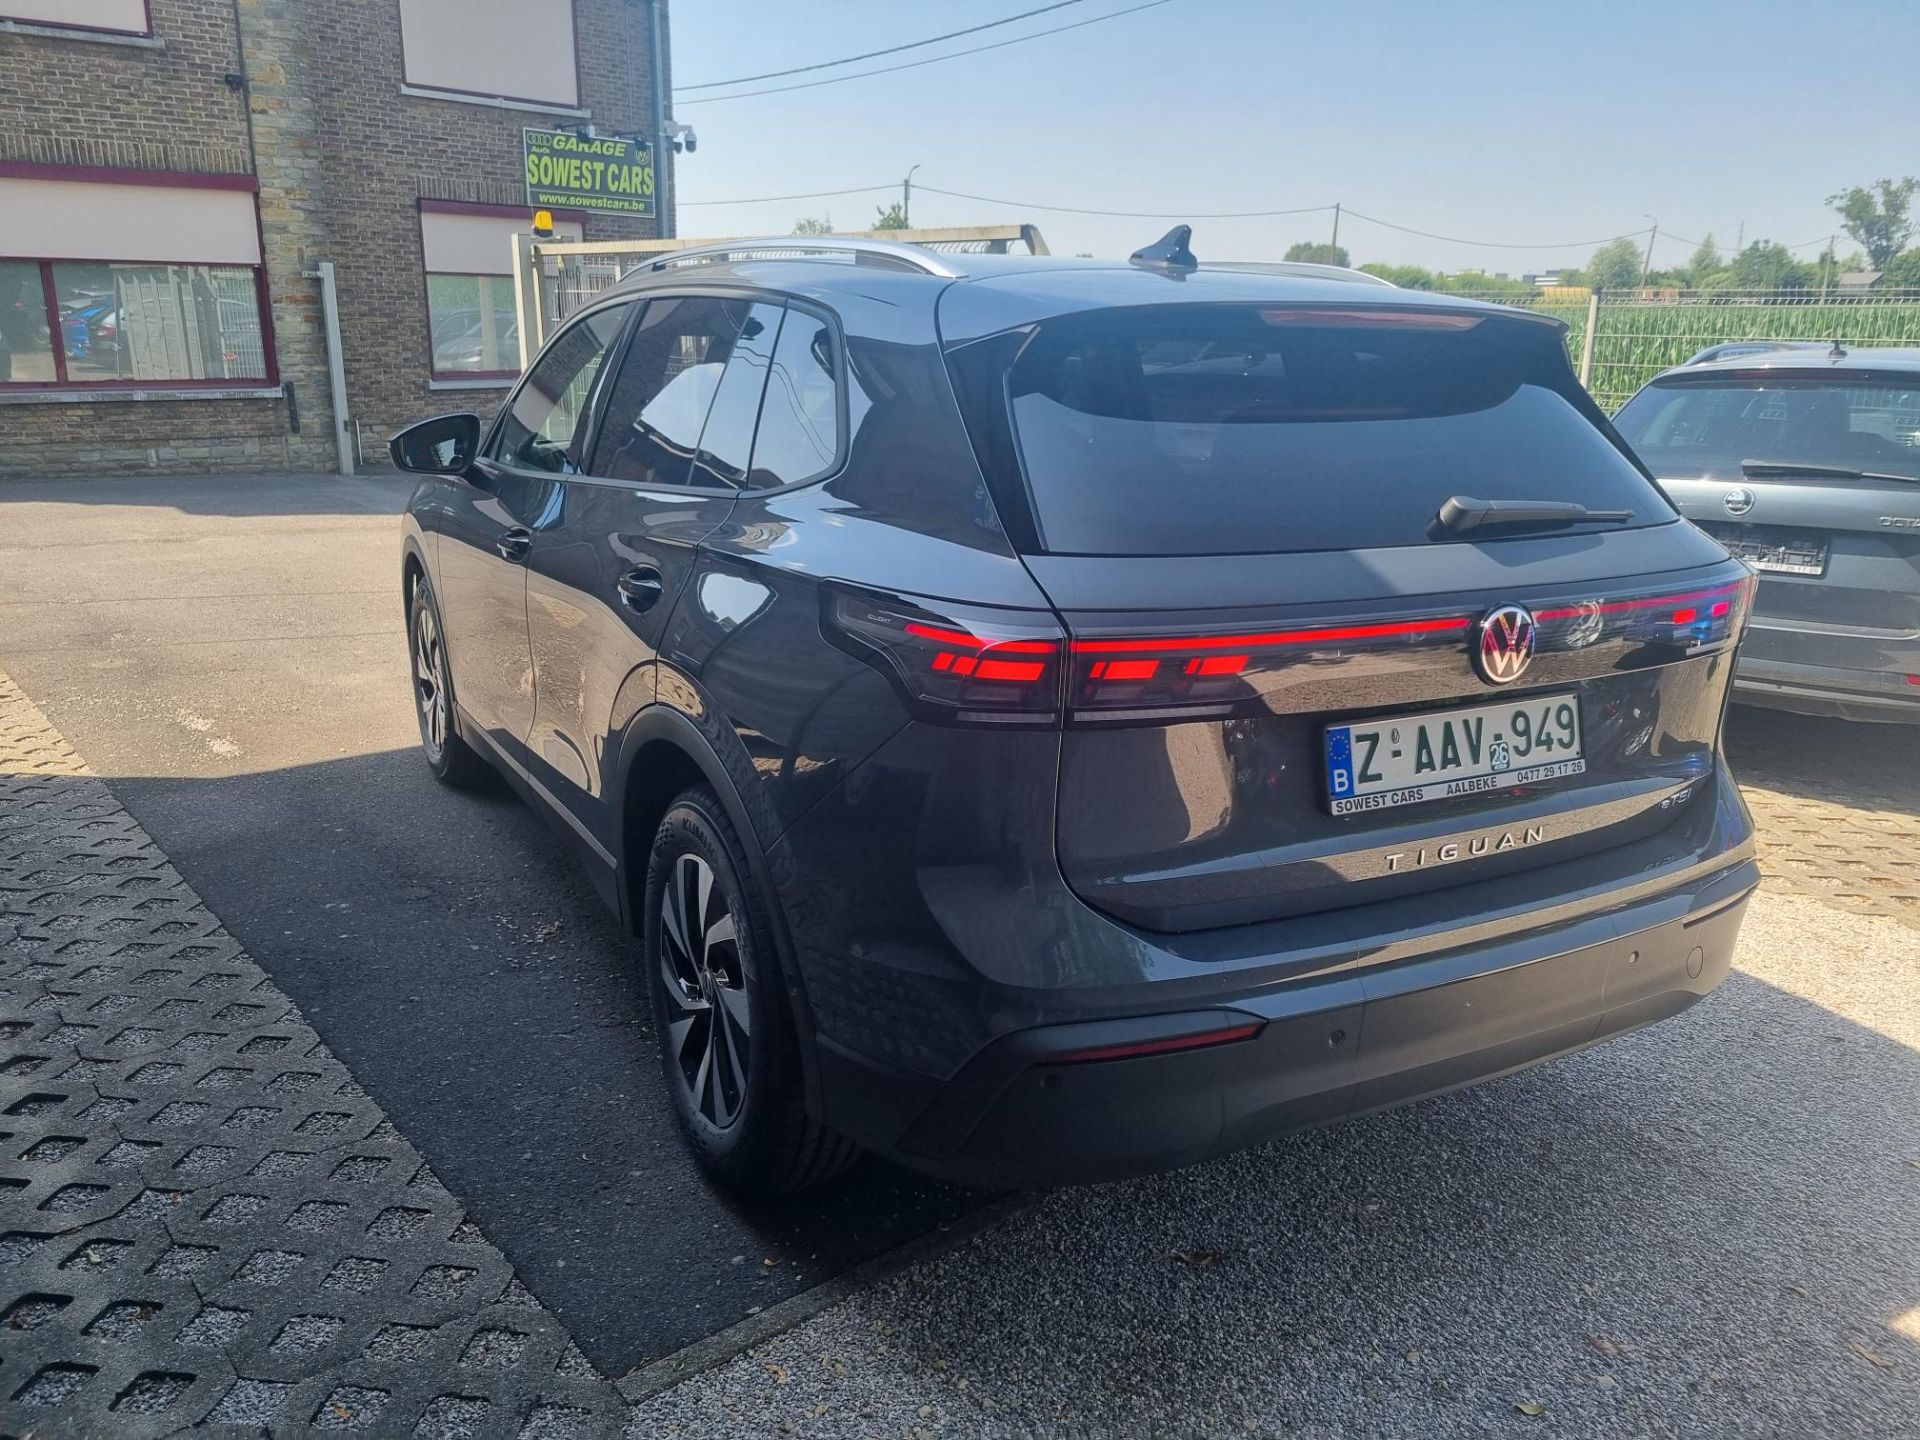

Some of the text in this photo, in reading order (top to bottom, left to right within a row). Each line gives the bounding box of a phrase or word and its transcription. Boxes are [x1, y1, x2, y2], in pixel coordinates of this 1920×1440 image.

[553, 135, 626, 157] GARAGE
[528, 154, 653, 195] SOWEST CARS
[539, 193, 645, 211] www.sowestcars.be
[1490, 743, 1509, 765] 26
[1333, 769, 1349, 793] B
[1336, 761, 1583, 813] SOWEST CARS AALBEKE 0477 29 17 26
[1384, 826, 1544, 870] TIGUAN
